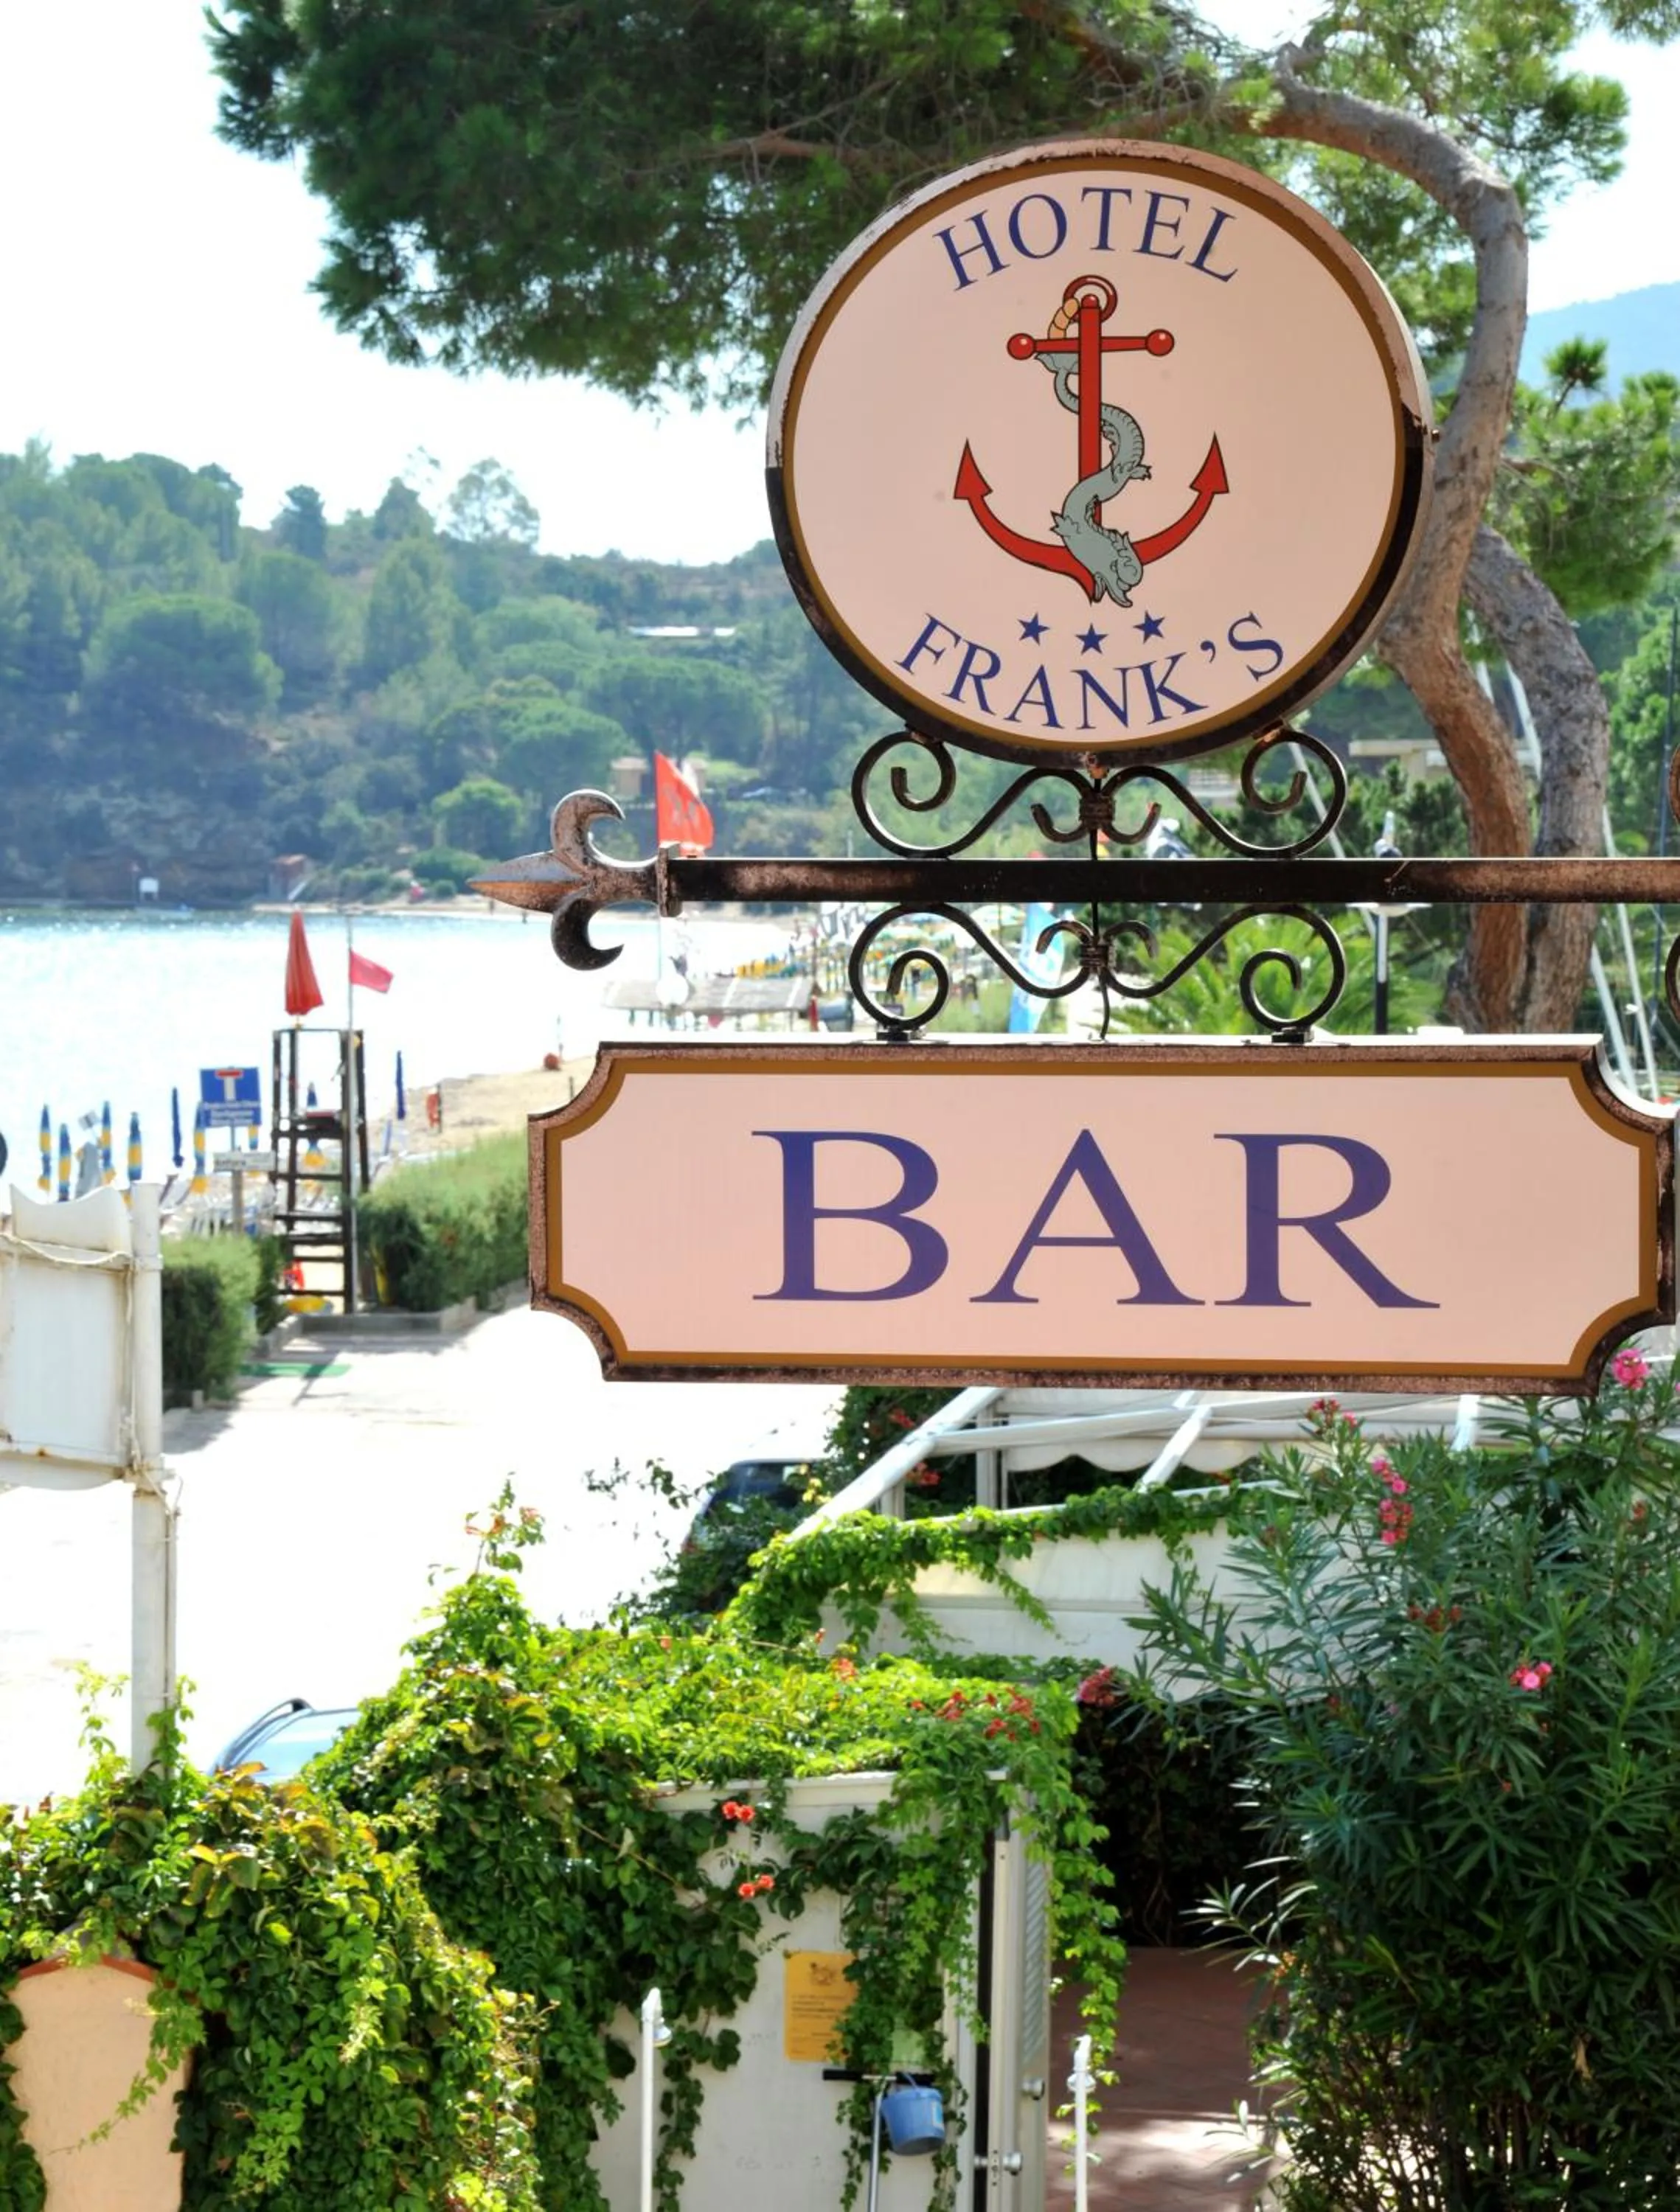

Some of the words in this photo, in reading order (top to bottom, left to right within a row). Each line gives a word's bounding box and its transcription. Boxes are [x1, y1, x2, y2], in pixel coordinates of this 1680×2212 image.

[932, 187, 1238, 291] HOTEL
[894, 612, 1284, 730] FRANK'S
[752, 1129, 1440, 1308] BAR
